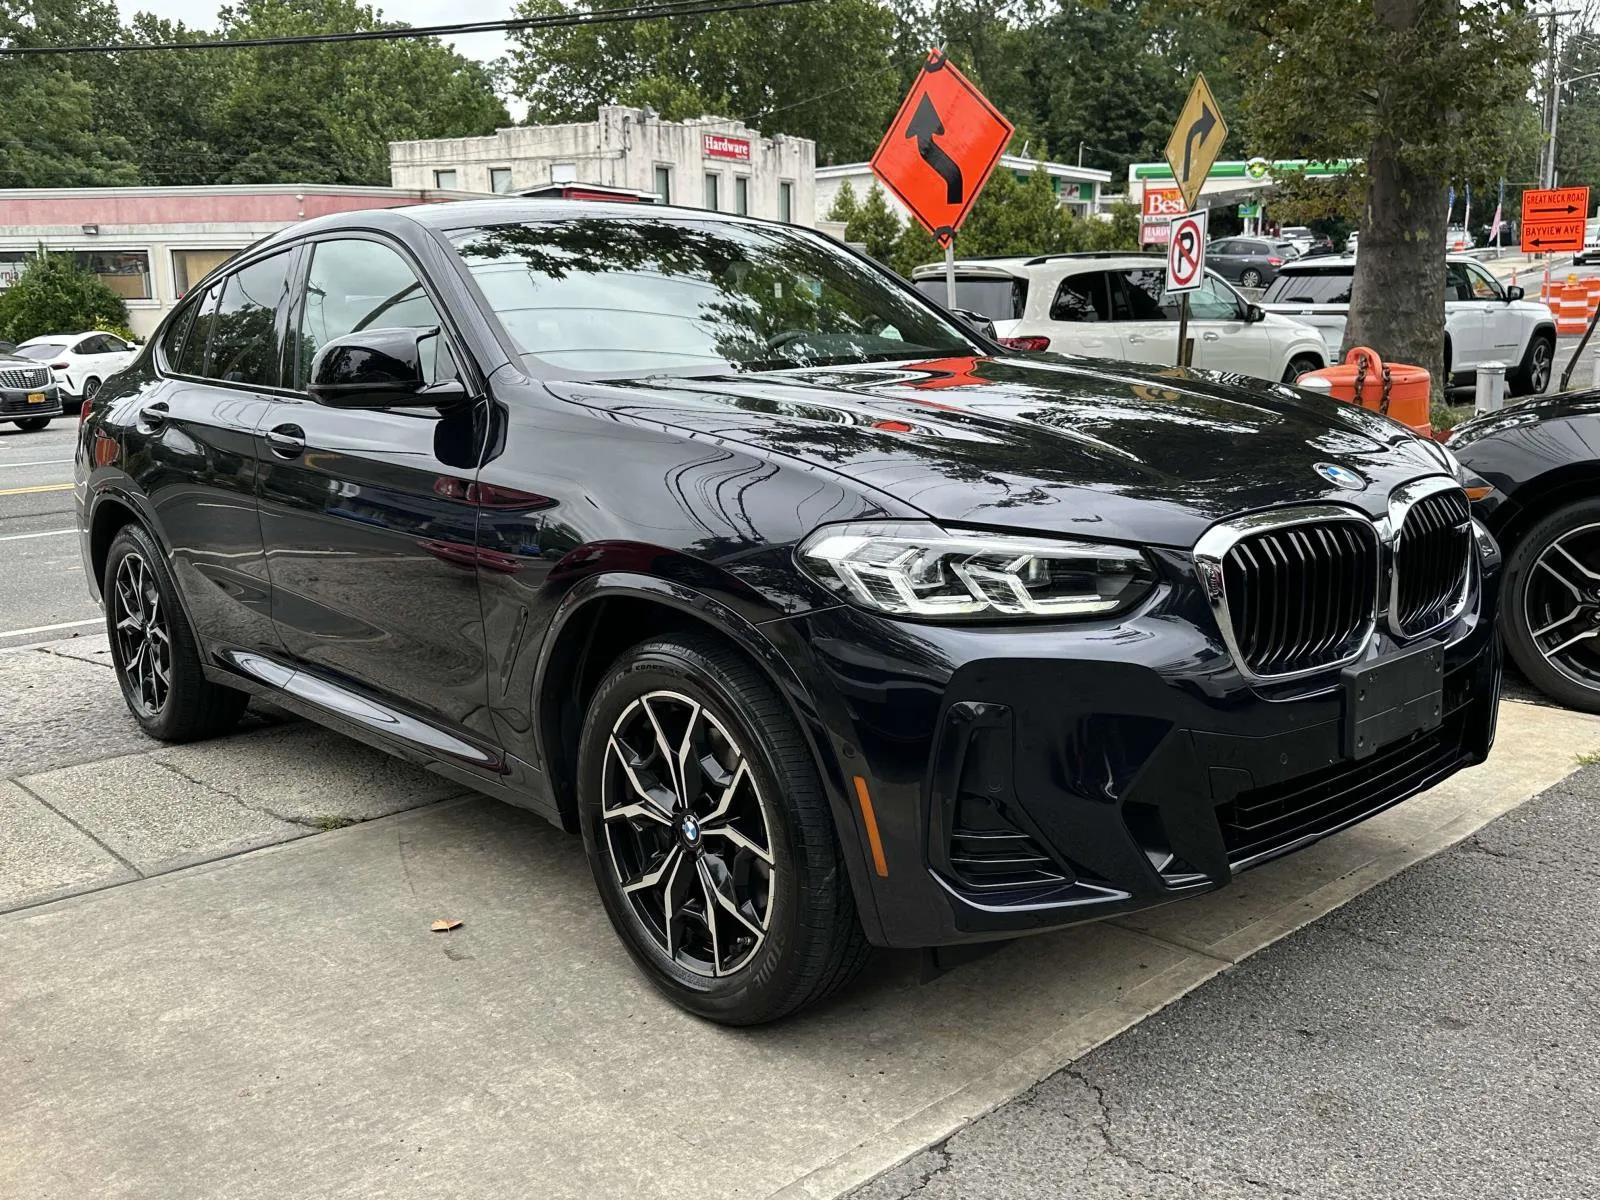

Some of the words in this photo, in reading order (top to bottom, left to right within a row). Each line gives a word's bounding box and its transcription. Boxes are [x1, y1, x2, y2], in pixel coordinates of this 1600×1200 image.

[705, 136, 748, 155] Hardware
[1149, 194, 1186, 214] Best
[1527, 194, 1547, 205] GREAT
[1548, 193, 1565, 203] NECK
[1567, 193, 1584, 202] ROAD
[1526, 226, 1561, 236] BAYVIEW
[1563, 225, 1580, 234] AVE
